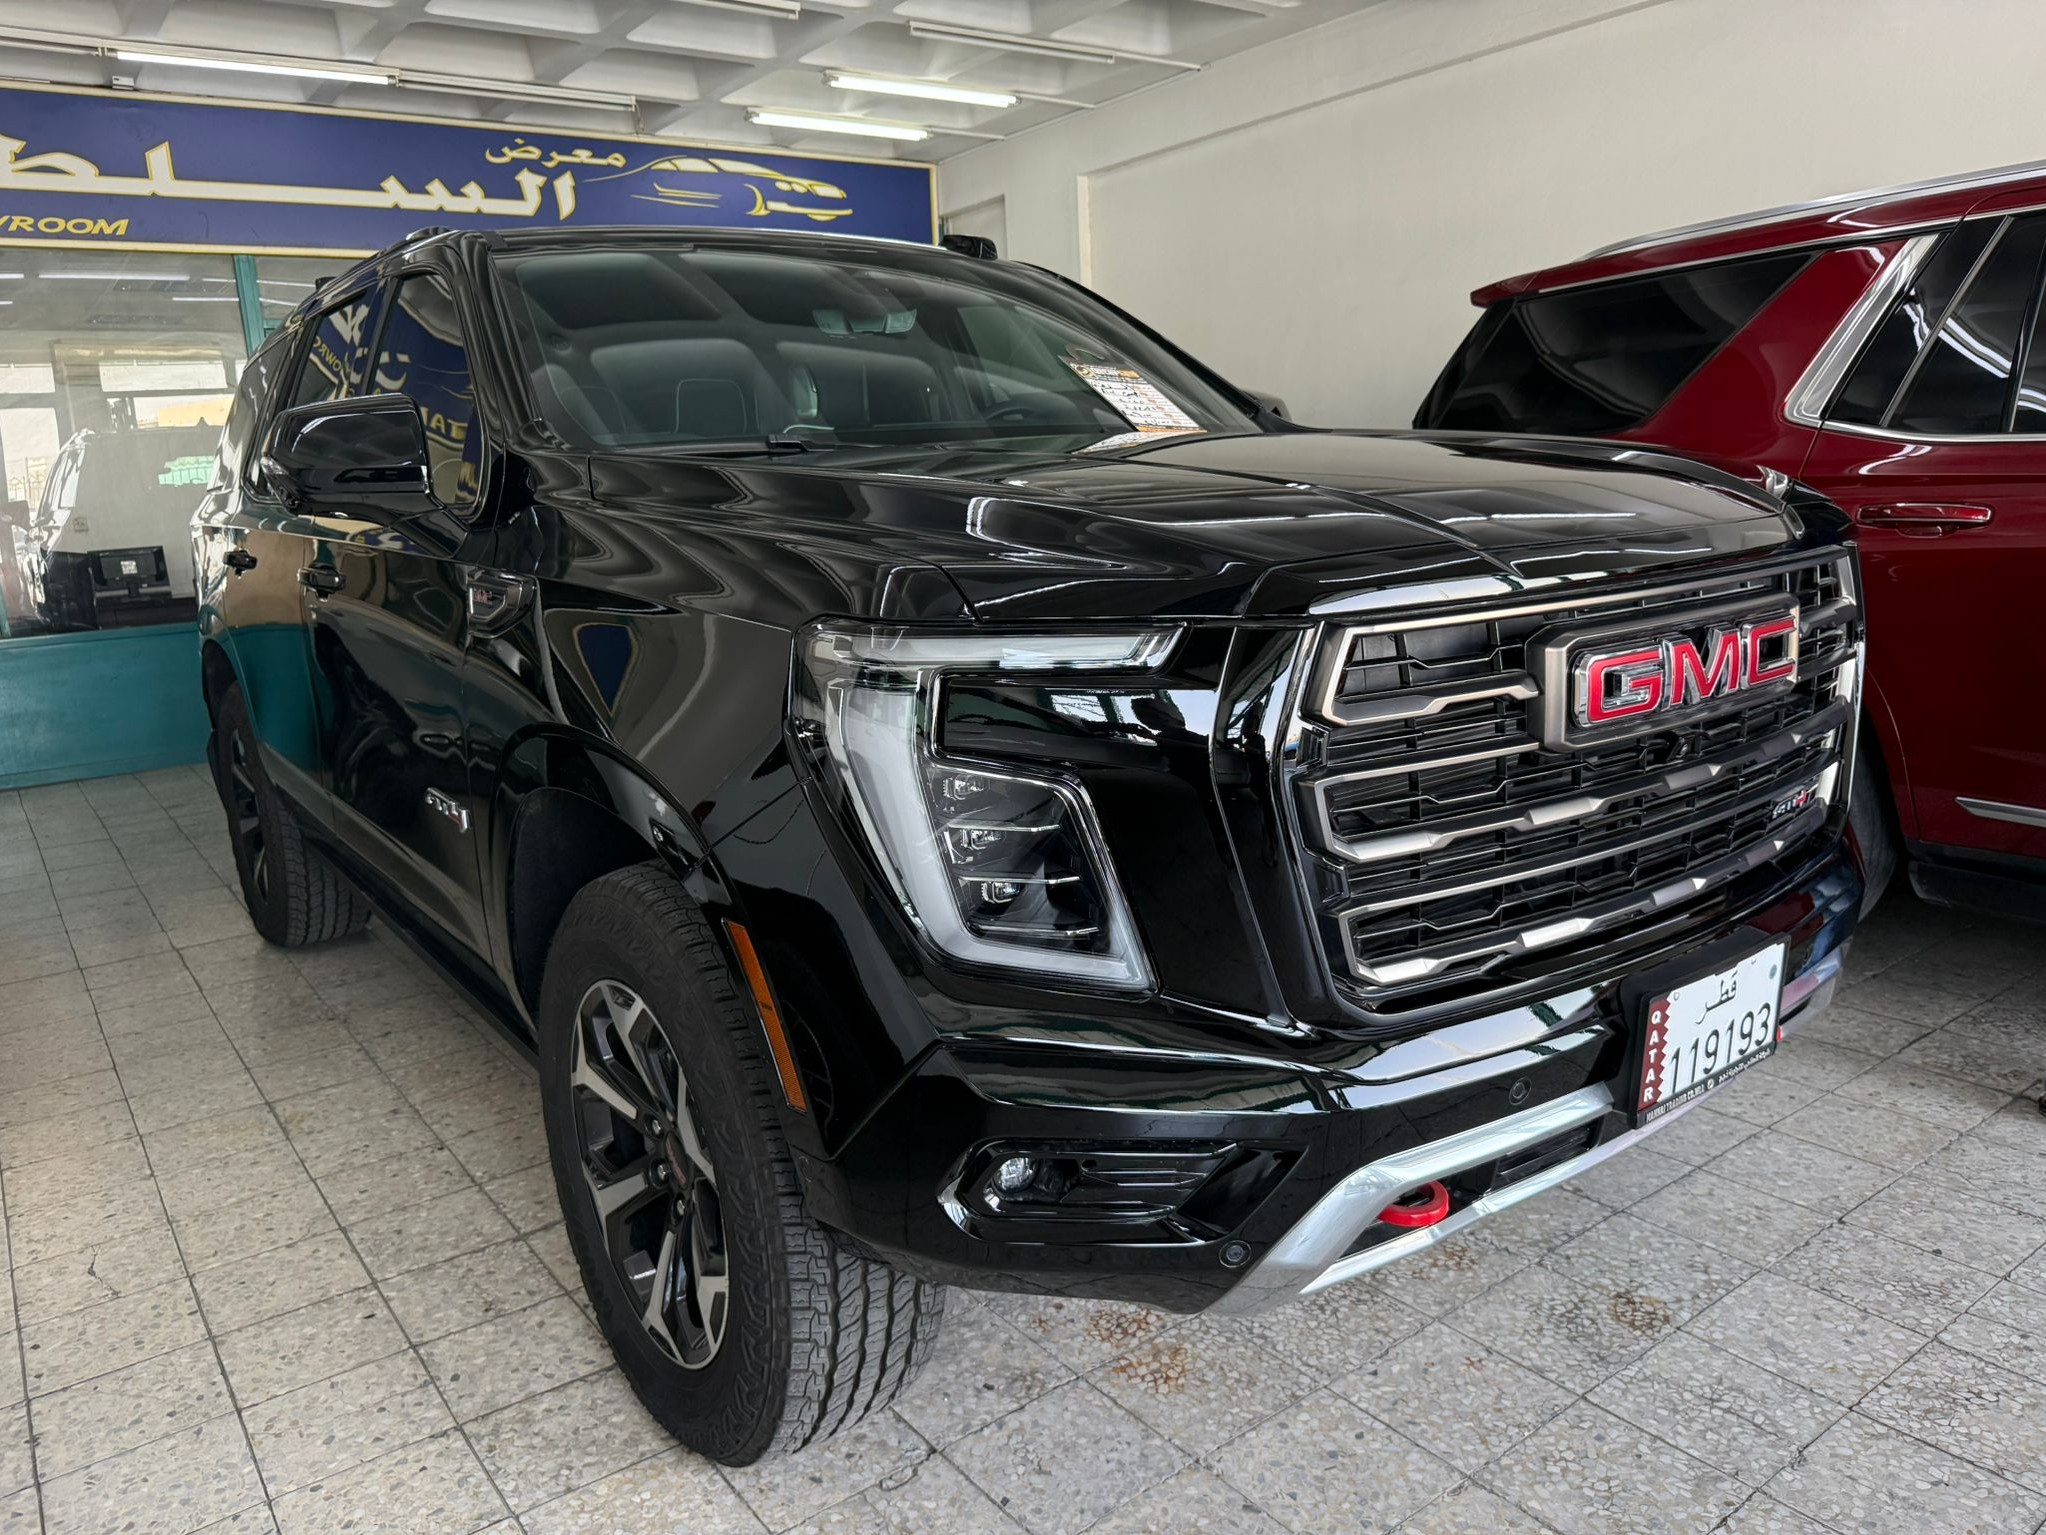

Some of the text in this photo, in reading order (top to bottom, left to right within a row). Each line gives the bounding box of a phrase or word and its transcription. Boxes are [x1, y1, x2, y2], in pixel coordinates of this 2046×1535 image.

[0, 134, 576, 221] السلط
[485, 138, 627, 168] معرض
[0, 215, 129, 236] ROOM
[1575, 616, 1798, 727] GMC
[1695, 970, 1738, 1025] قطر
[1643, 1010, 1662, 1103] QATAR
[1671, 1002, 1771, 1094] 119193
